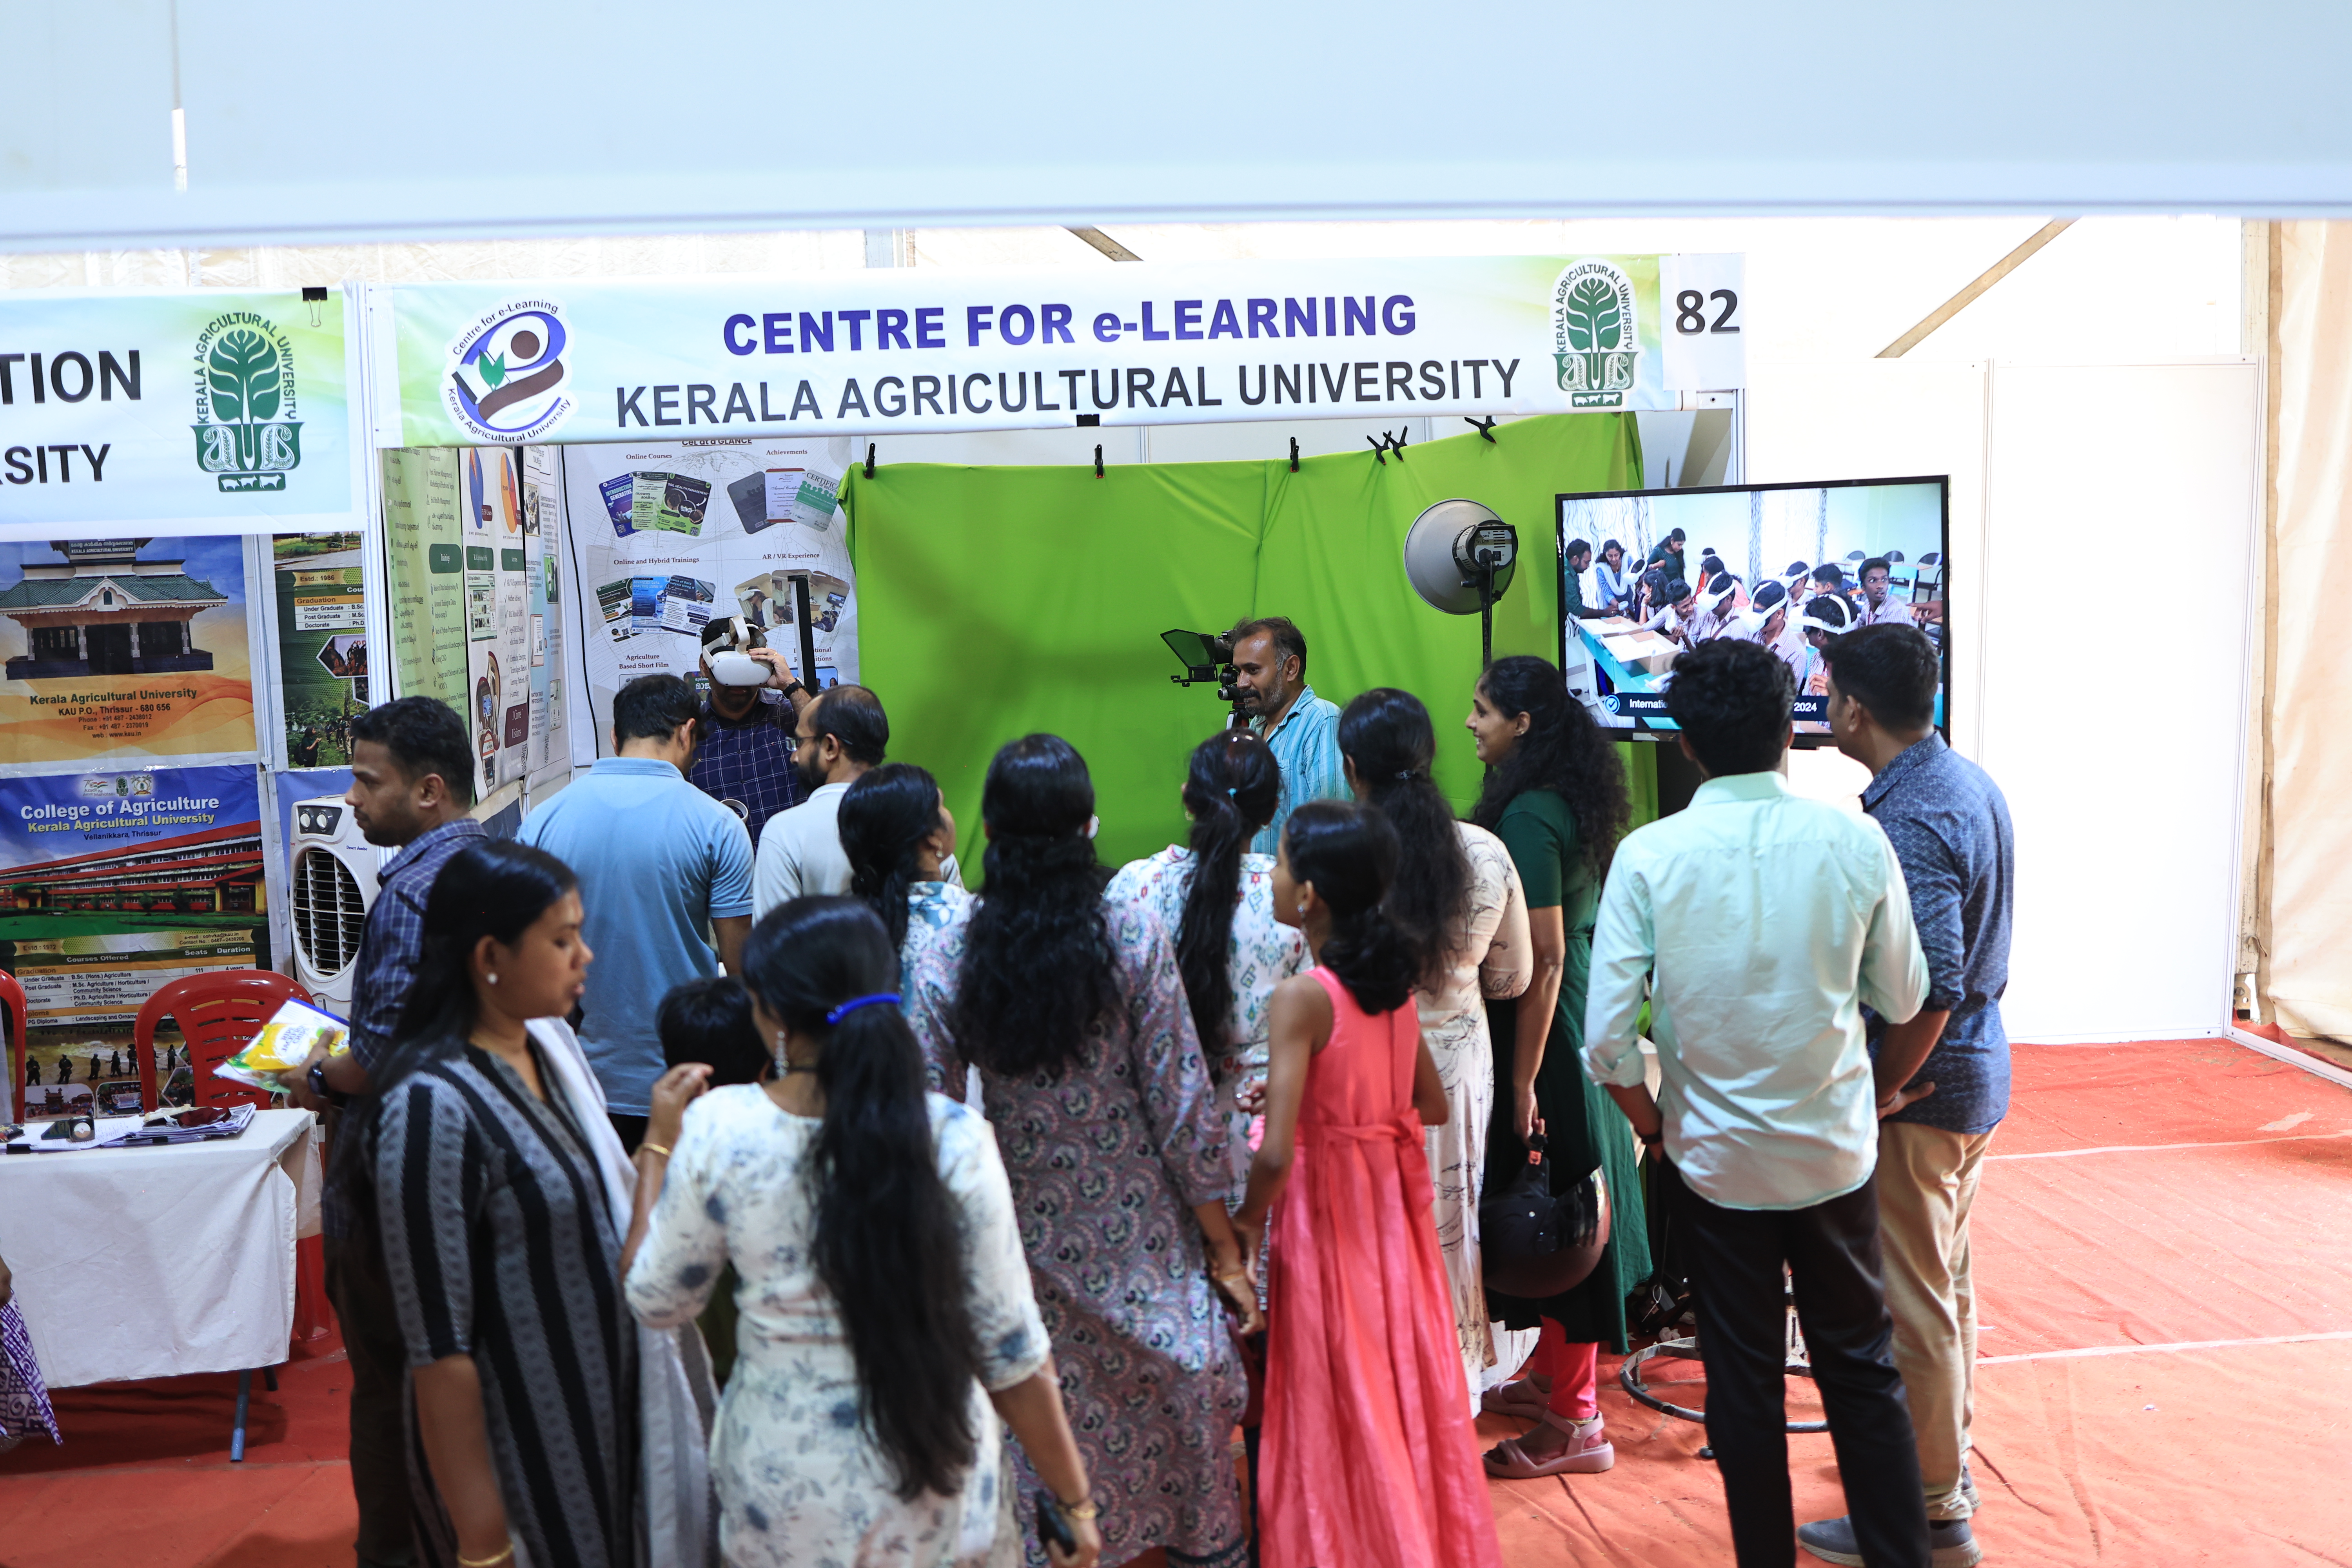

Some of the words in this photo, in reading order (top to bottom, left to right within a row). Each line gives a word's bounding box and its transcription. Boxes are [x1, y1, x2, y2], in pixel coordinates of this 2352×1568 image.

[1555, 264, 1620, 305] AGRICULTURAL
[453, 326, 481, 355] Centre
[481, 314, 496, 326] for
[499, 299, 558, 316] e-Learning
[724, 307, 946, 356] CENTRE
[967, 304, 1075, 347] FOR
[1093, 295, 1415, 343] e-LEARNING
[1555, 307, 1567, 353] KERALA
[1619, 284, 1633, 350] UNIVERSITY
[1676, 289, 1740, 336] 82
[194, 312, 278, 363] AGRICULTURAL
[0, 350, 141, 405] TION
[194, 367, 209, 424] KERALA
[277, 336, 296, 419] UNIVERSITY
[617, 379, 833, 428] KERALA
[837, 367, 1222, 419] AGRICULTURAL
[1239, 358, 1521, 405] UNIVERSITY
[448, 388, 465, 421] Kerala
[465, 421, 526, 442] Agricultural
[528, 399, 571, 438] University
[0, 443, 111, 485] SITY
[648, 557, 670, 565] Hybrid
[29, 695, 67, 705] Kerala
[71, 691, 136, 705] Agricultural
[140, 688, 197, 700] University
[58, 707, 76, 716] KAU
[79, 707, 98, 715] P.O.,
[99, 706, 133, 714] Thrissur
[156, 703, 171, 711] 656
[1794, 702, 1817, 712] 2024
[511, 728, 522, 739] Visitors
[20, 804, 90, 821] College
[96, 800, 114, 815] of
[119, 796, 220, 818] Agriculture
[28, 822, 70, 833] Kerala
[74, 816, 148, 833] Agricultural
[152, 813, 215, 825] University
[83, 831, 130, 841] Vellanikkara,
[132, 830, 162, 838] Thrissur
